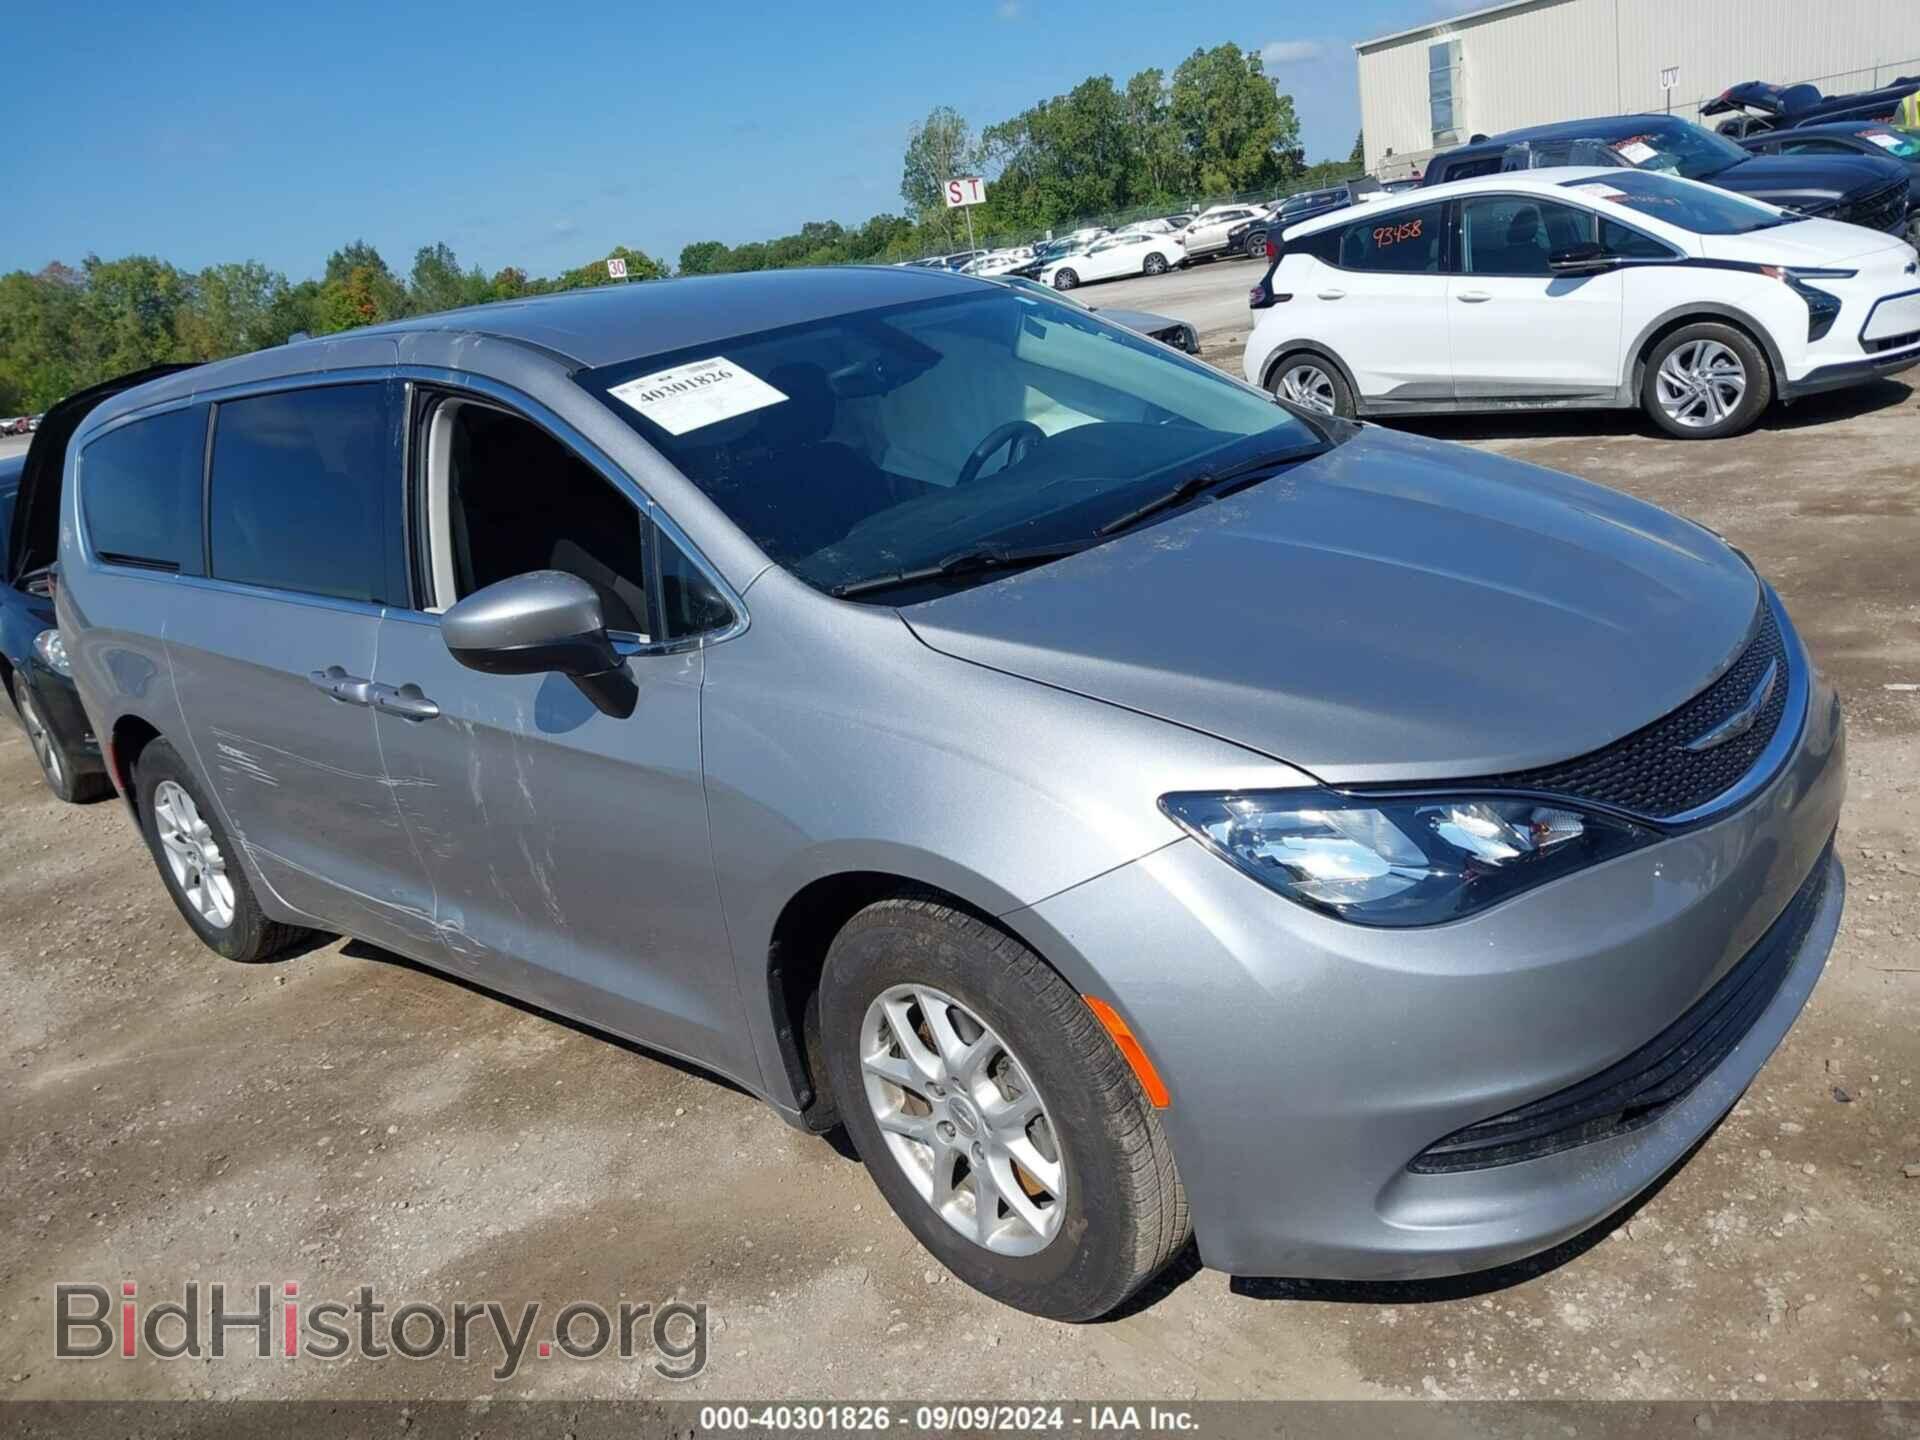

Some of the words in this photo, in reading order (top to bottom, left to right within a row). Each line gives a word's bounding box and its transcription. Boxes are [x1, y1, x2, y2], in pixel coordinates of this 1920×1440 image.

[1373, 219, 1422, 248] 93458
[609, 260, 625, 275] 30
[640, 368, 733, 403] 40301826
